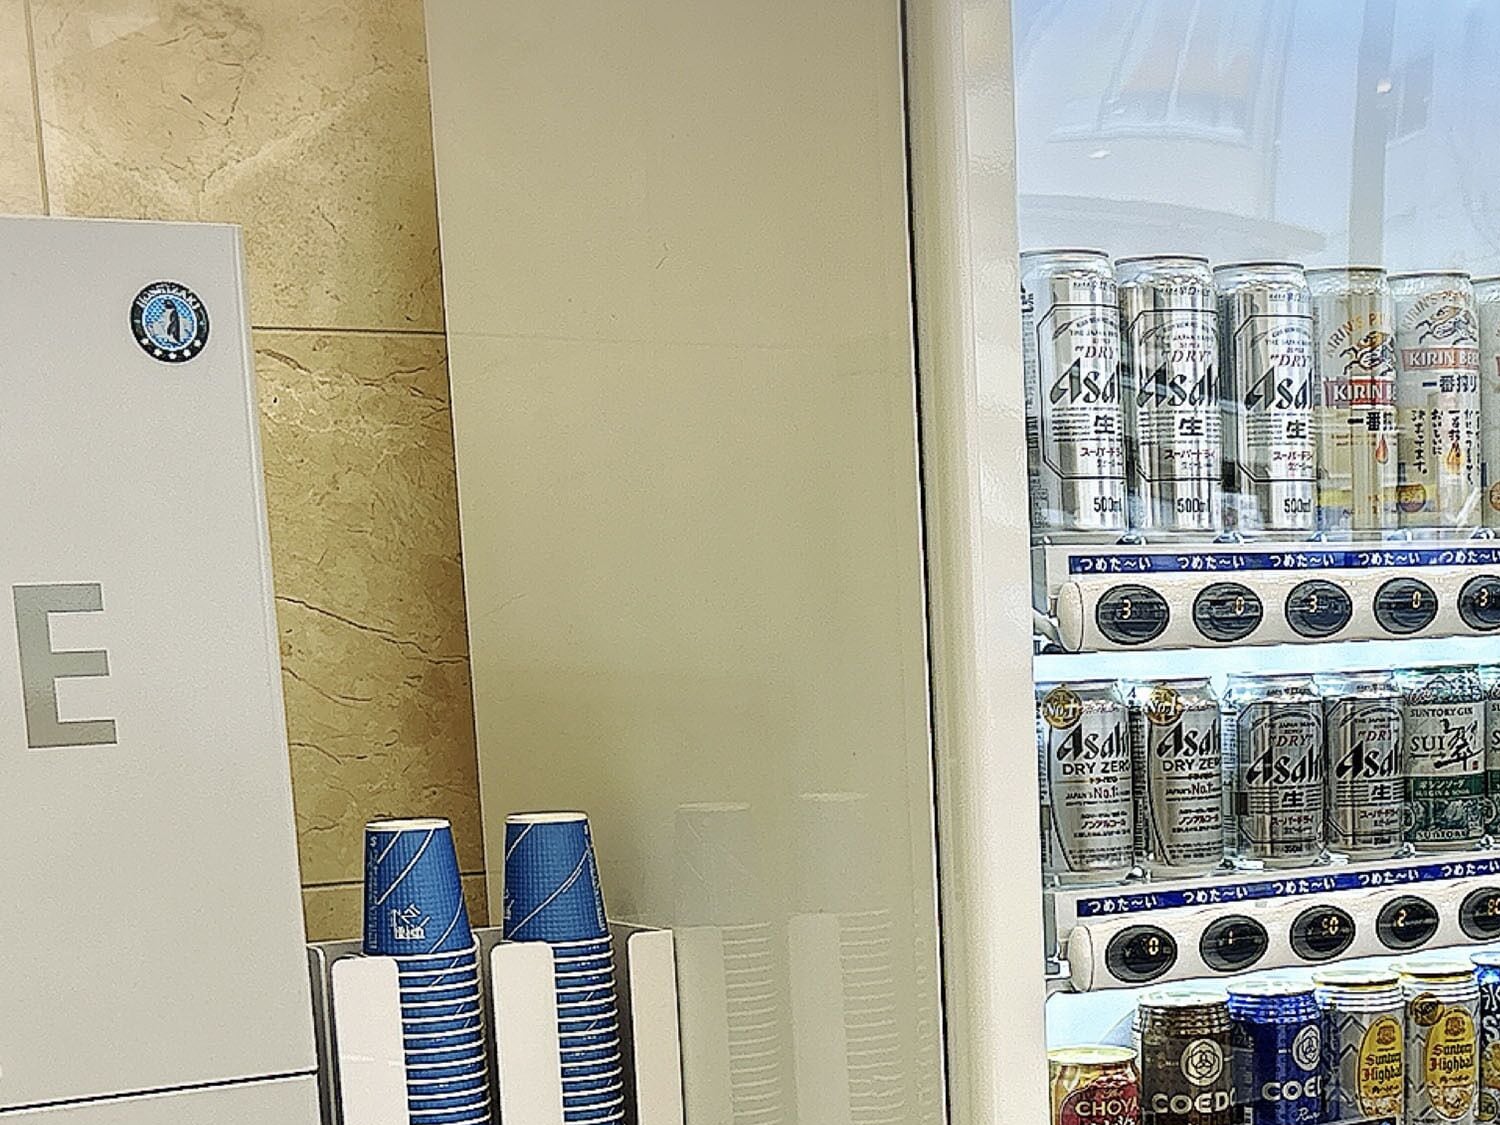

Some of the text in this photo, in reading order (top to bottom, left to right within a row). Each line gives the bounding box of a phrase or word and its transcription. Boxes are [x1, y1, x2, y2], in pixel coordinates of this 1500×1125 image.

[1409, 350, 1479, 367] KIRIN BEE
[1334, 384, 1382, 401] KIRIN
[1093, 415, 1116, 435] 生
[1179, 416, 1205, 437] 生
[1286, 419, 1307, 439] 生
[12, 583, 117, 749] E
[1410, 735, 1446, 752] SUI
[1062, 762, 1095, 776] DRY
[1162, 757, 1221, 773] DRY ZER
[1247, 745, 1323, 785] Asah
[1282, 791, 1304, 808] 生
[1371, 784, 1394, 801] 生
[1262, 1077, 1323, 1102] COE
[1075, 1099, 1139, 1117] CHOYA
